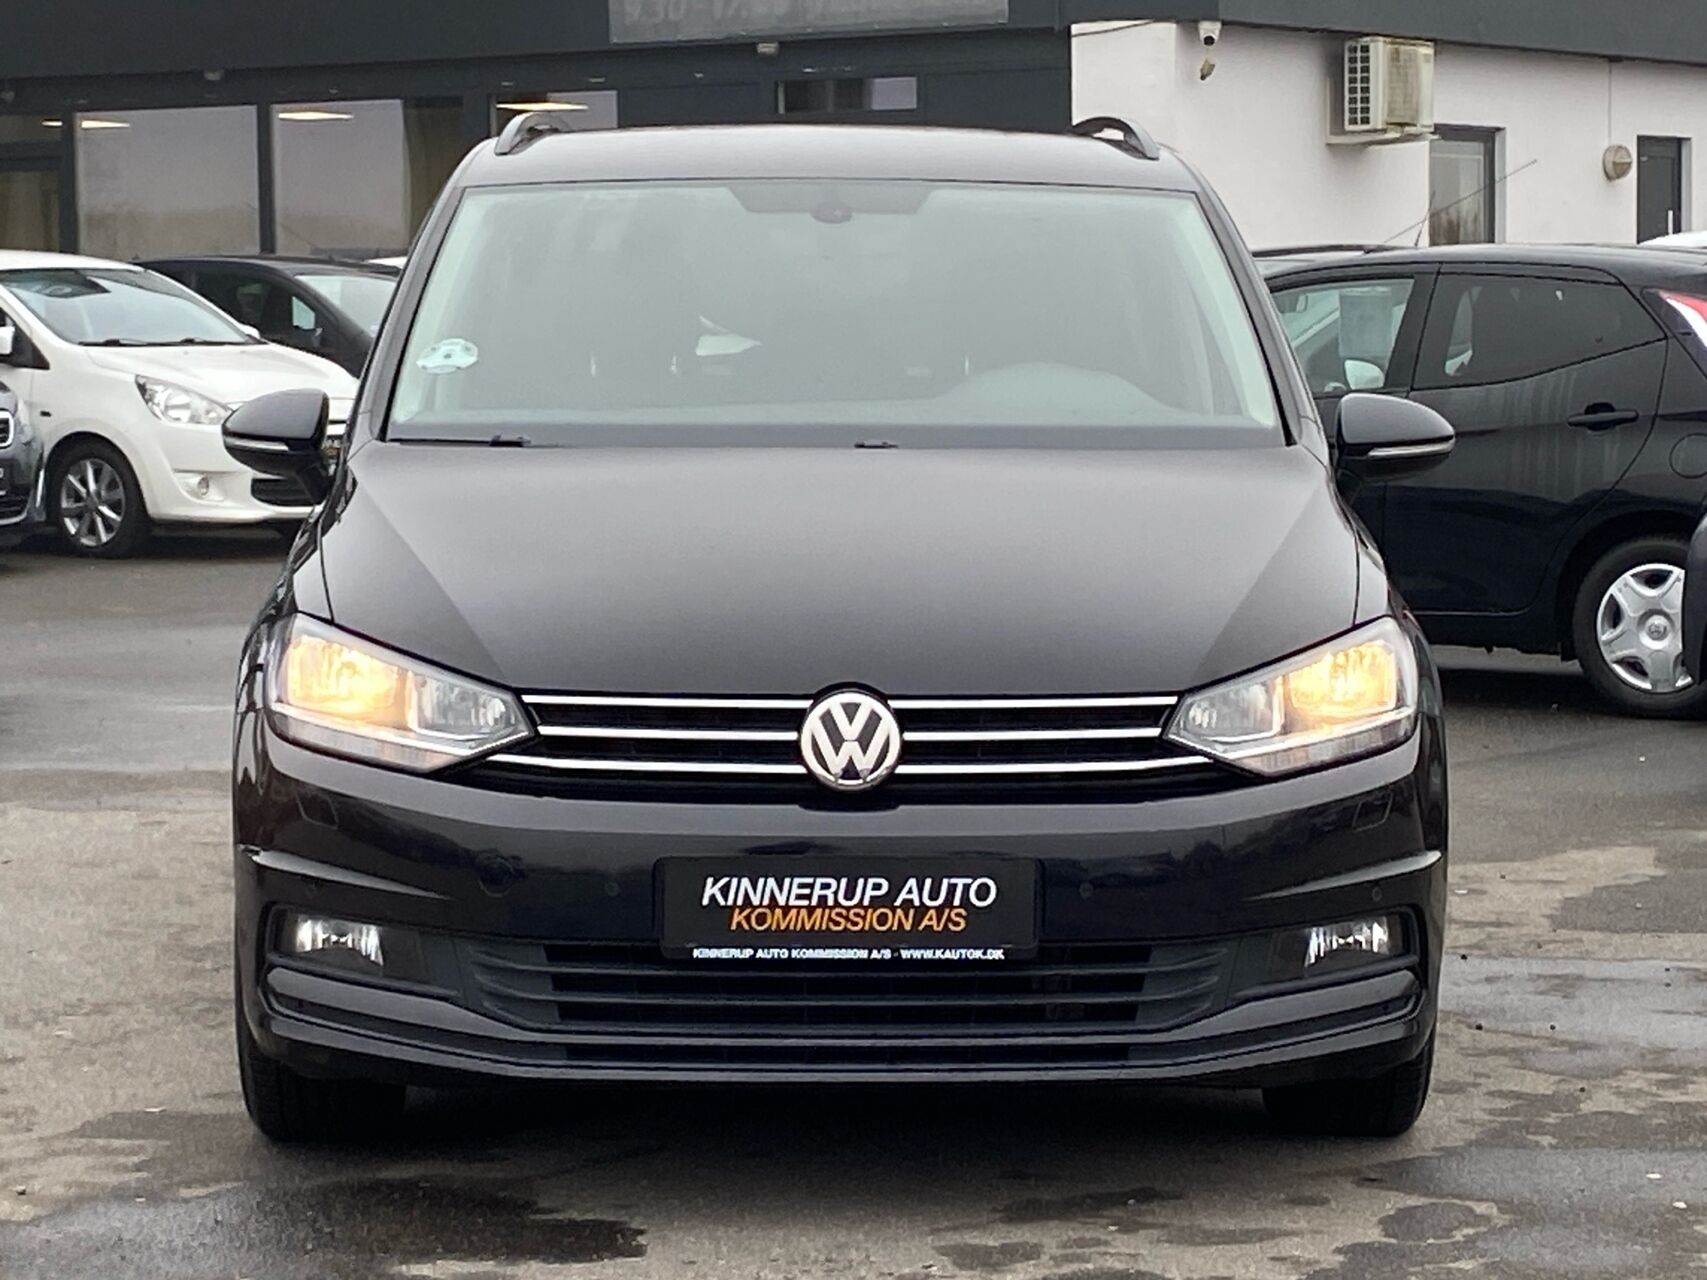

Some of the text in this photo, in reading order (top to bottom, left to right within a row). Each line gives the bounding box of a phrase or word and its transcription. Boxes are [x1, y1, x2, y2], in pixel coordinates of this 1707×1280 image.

[701, 876, 997, 907] KINNERUP AUTO
[730, 907, 968, 931] KOMMISSION A/S
[755, 948, 788, 959] AUTO
[869, 948, 892, 959] A/S
